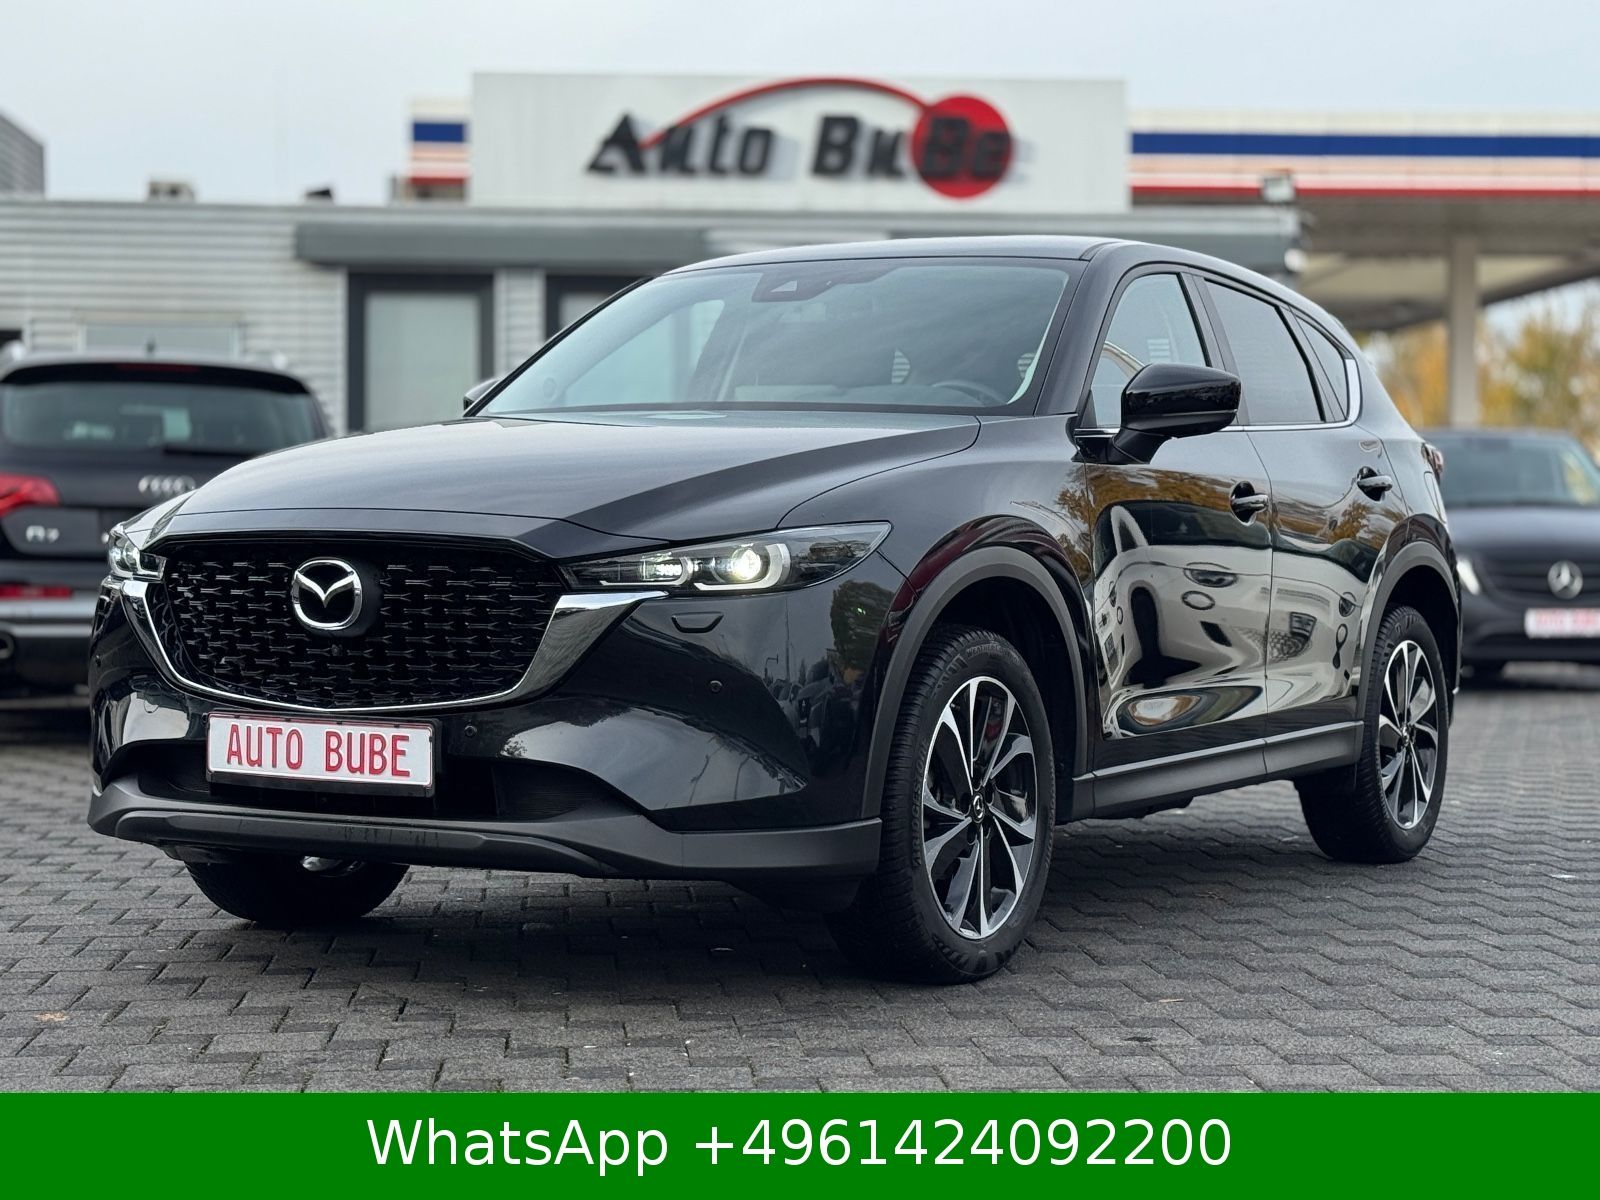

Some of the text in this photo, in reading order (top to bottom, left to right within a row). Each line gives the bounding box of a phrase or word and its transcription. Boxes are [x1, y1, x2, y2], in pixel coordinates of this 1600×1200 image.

[586, 112, 774, 175] Auto
[227, 724, 411, 777] AUTO BUBE
